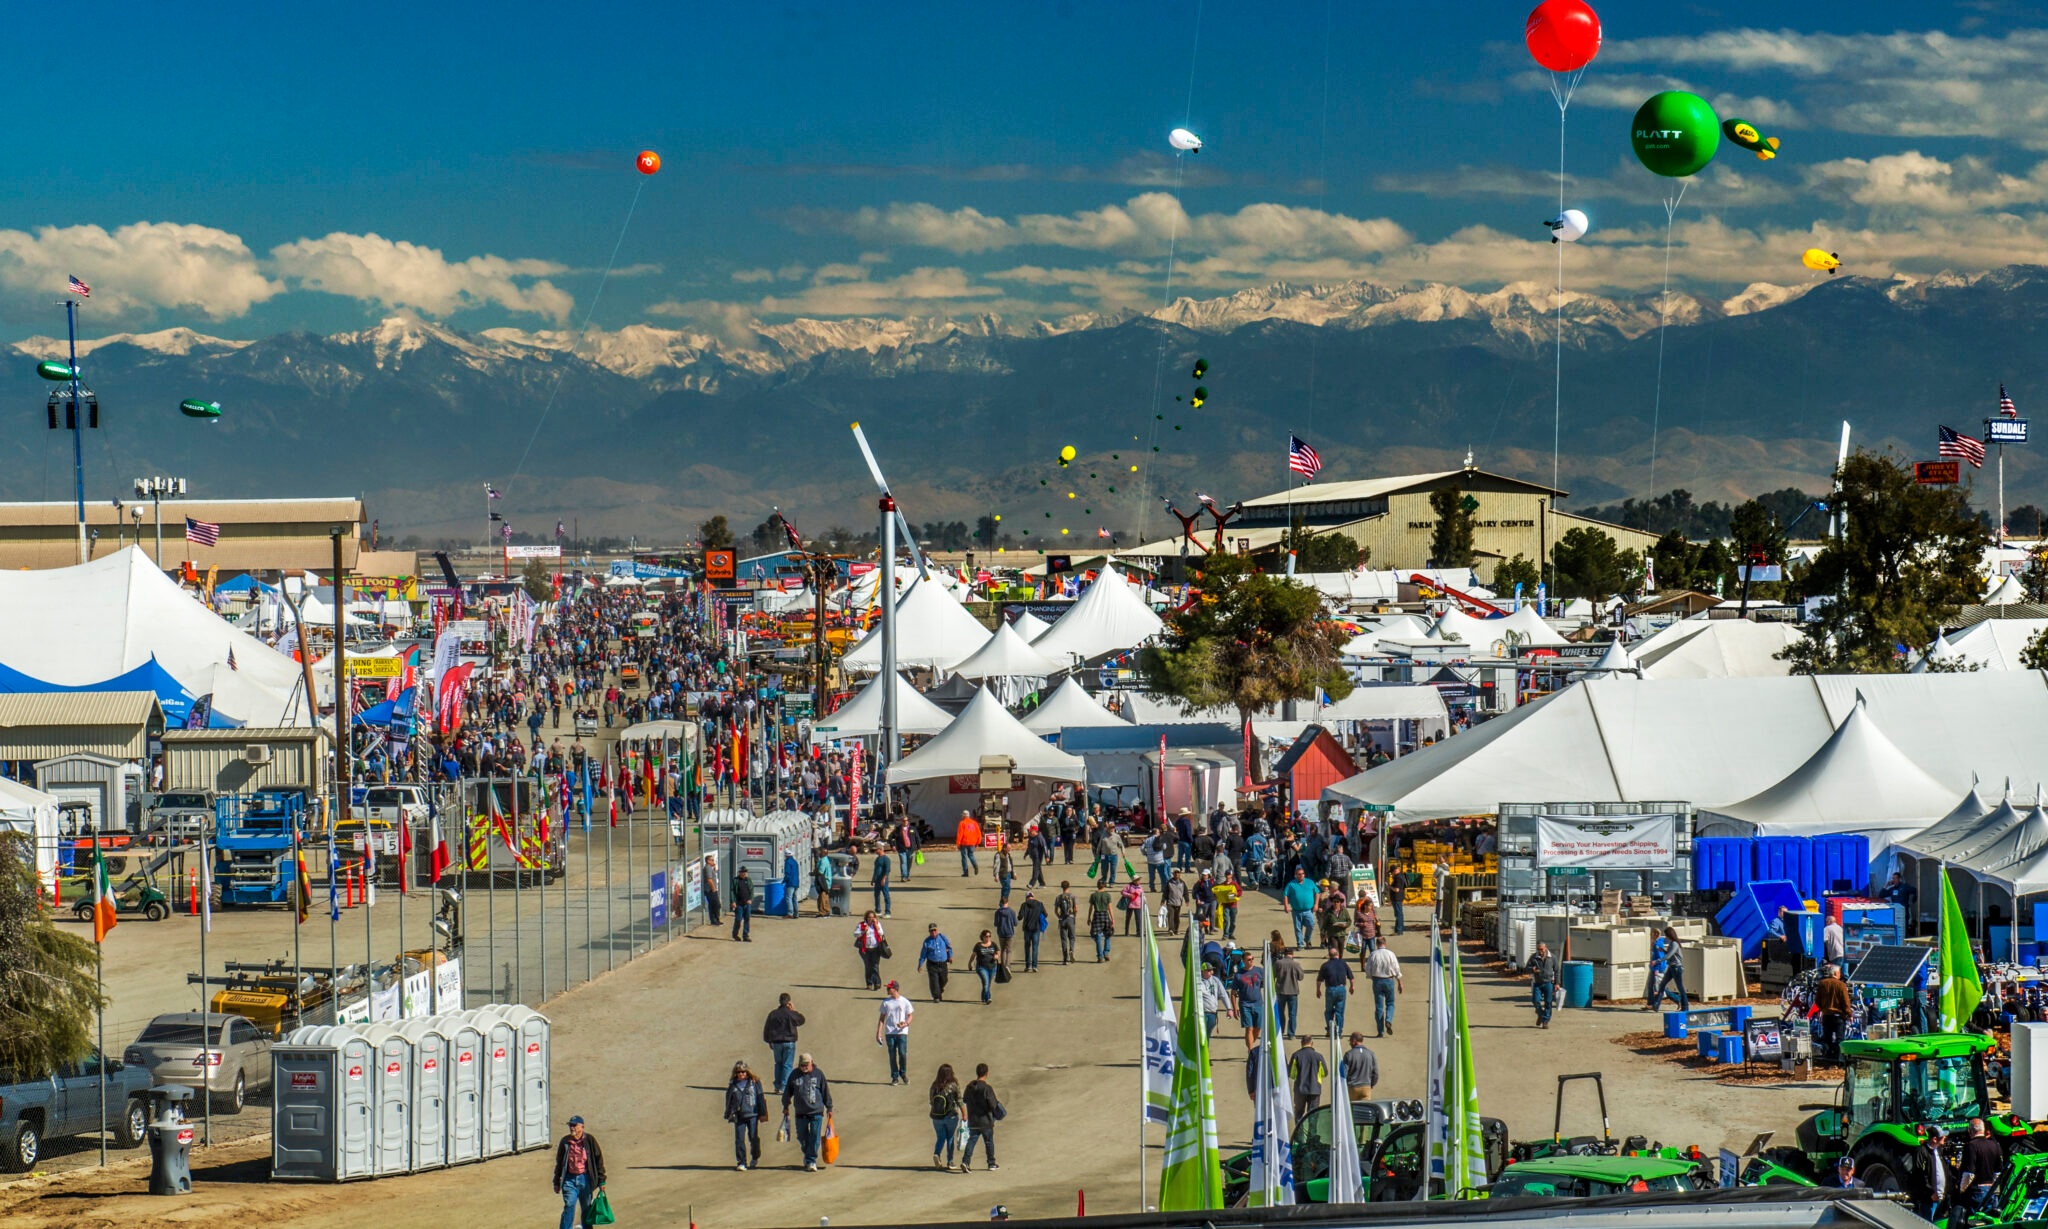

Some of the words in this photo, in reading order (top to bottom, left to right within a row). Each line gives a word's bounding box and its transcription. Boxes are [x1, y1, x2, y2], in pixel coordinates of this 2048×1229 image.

[1636, 130, 1682, 139] PLATT
[1991, 422, 2026, 434] SUNDALE
[1408, 521, 1432, 529] FARM
[1500, 520, 1534, 528] CENTER
[342, 578, 364, 586] AIR
[365, 579, 396, 587] FOOD
[1561, 647, 1591, 656] WHEEL
[389, 840, 397, 851] 5
[1551, 841, 1575, 849] Serving
[1543, 849, 1578, 857] Processing
[1586, 849, 1610, 857] Storage
[1872, 988, 1878, 997] D
[1880, 988, 1904, 997] STREET
[1755, 1031, 1779, 1046] AG
